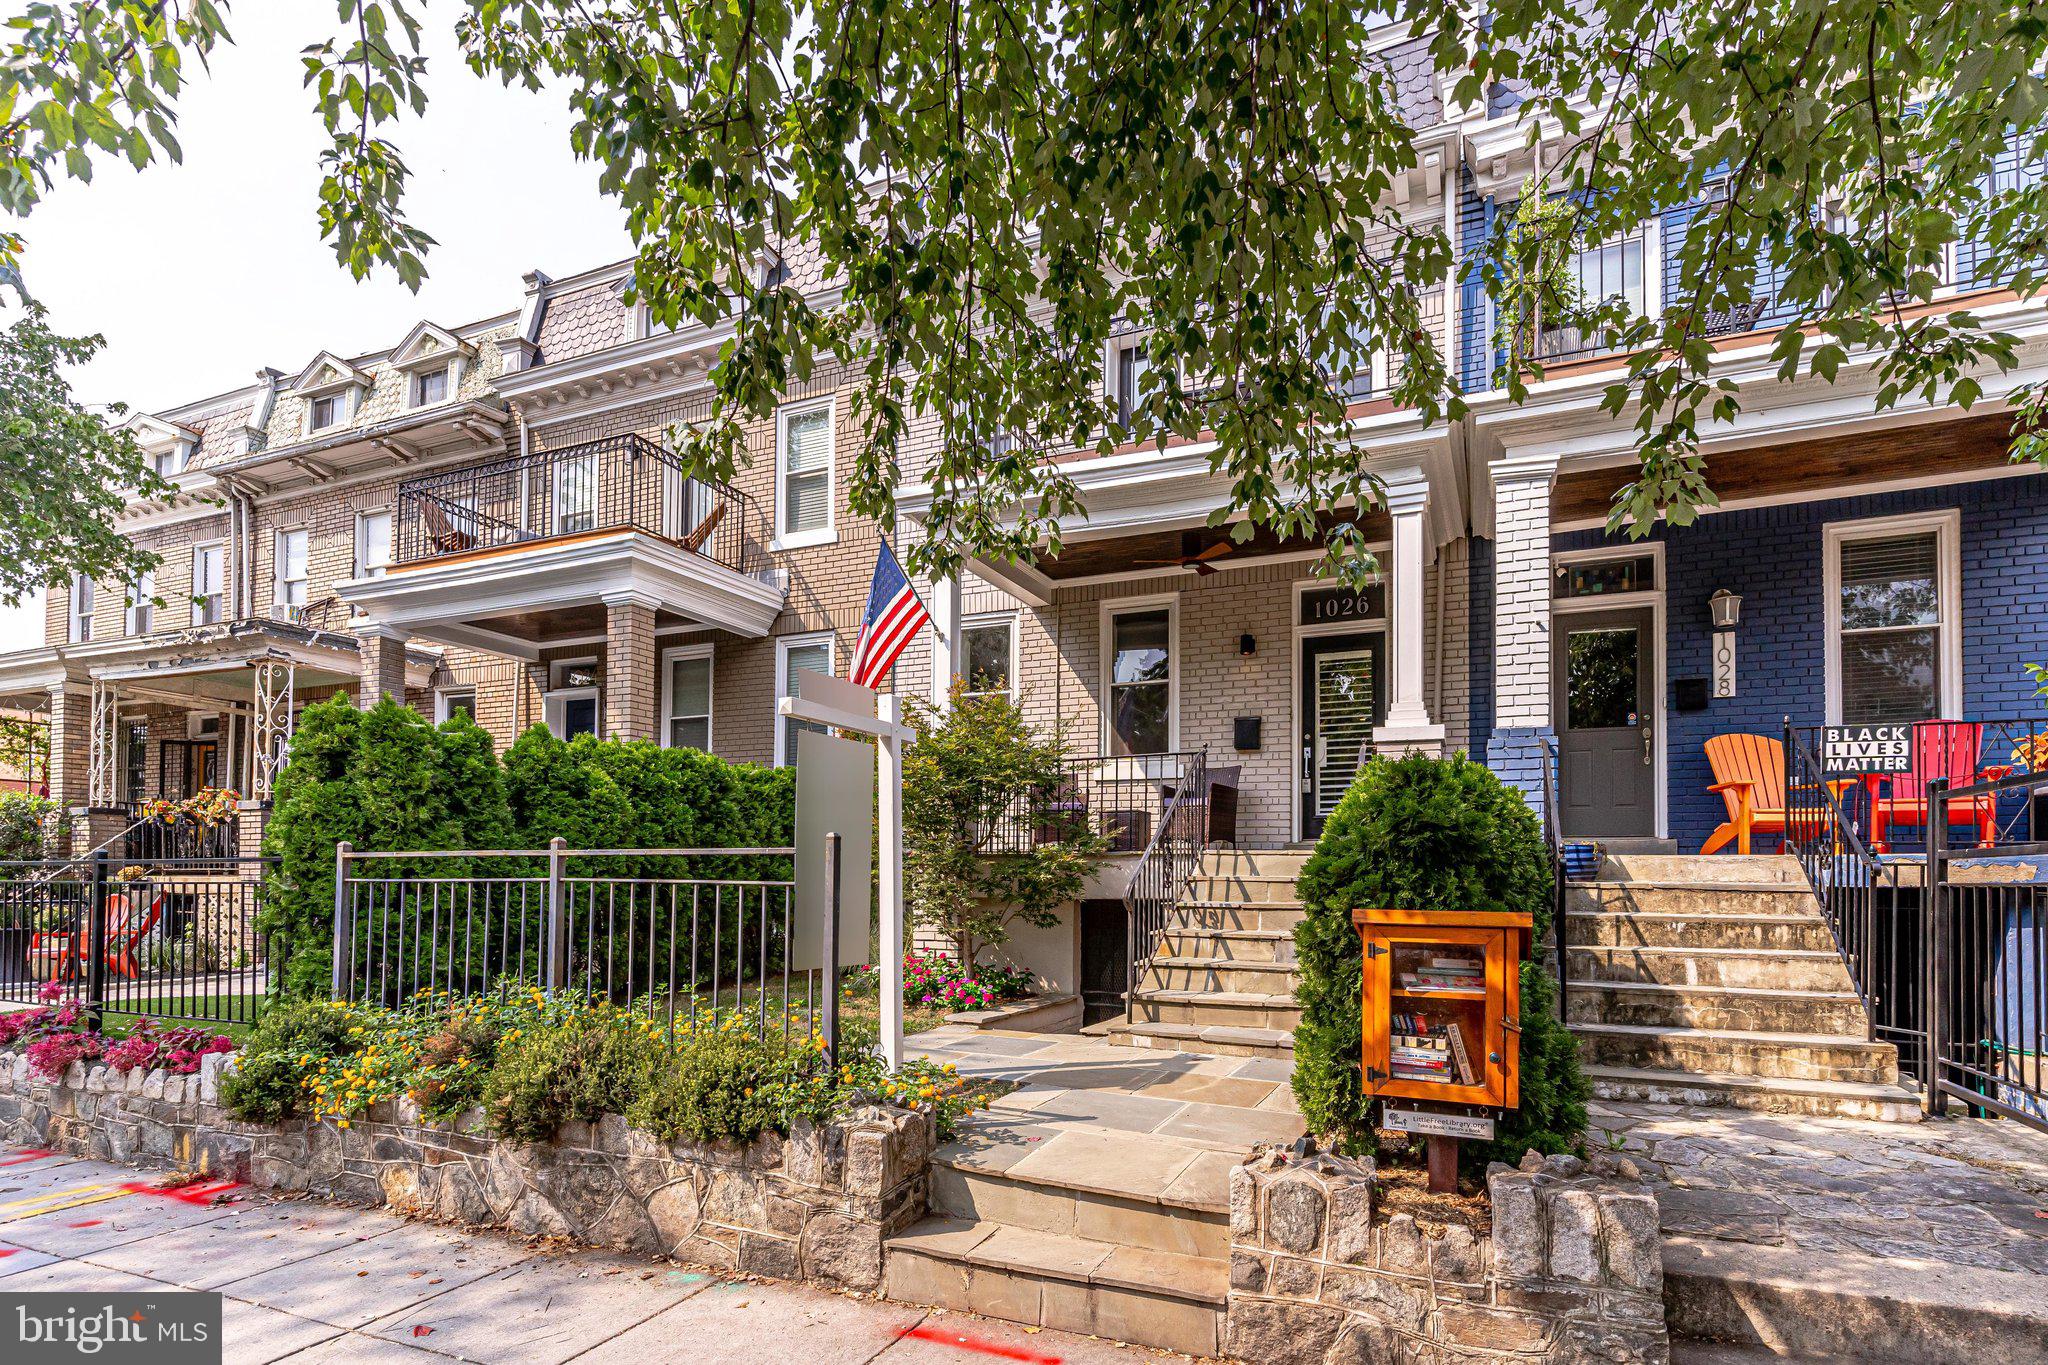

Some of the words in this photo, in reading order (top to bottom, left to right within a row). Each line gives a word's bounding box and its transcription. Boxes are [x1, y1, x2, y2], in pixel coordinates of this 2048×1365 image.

[1315, 596, 1369, 618] 1026
[1717, 632, 1731, 697] 1028
[1827, 727, 1906, 742] BLACK
[1832, 742, 1903, 756] LIVES
[1826, 757, 1908, 771] MATTER
